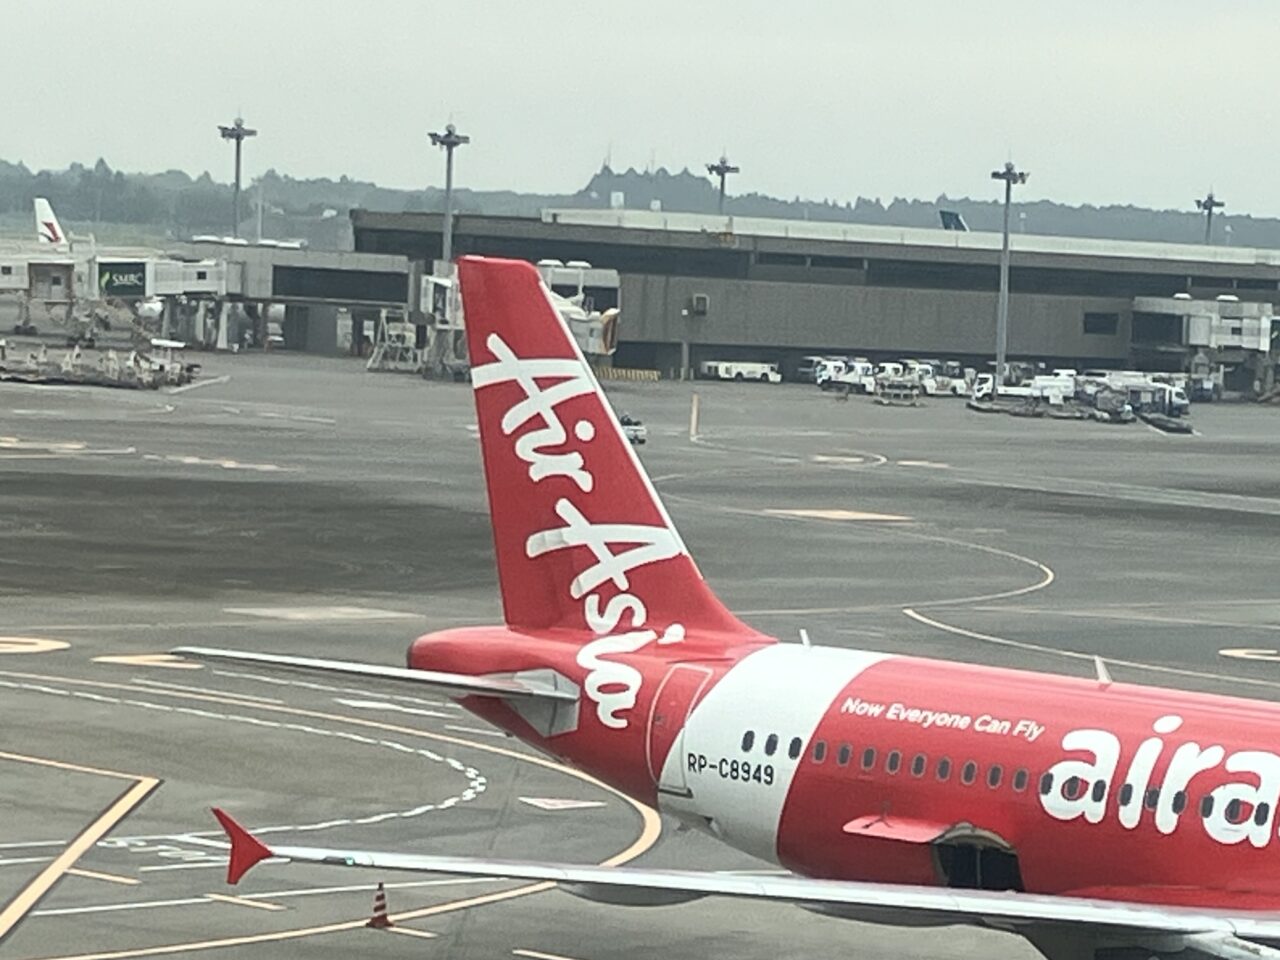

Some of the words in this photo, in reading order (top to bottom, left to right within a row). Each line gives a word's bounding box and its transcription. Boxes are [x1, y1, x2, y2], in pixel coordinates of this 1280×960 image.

[841, 697, 886, 717] Now
[885, 703, 972, 729] Everyone
[974, 714, 1011, 735] Can
[1012, 719, 1045, 742] Fly
[687, 752, 775, 786] RP-C8949
